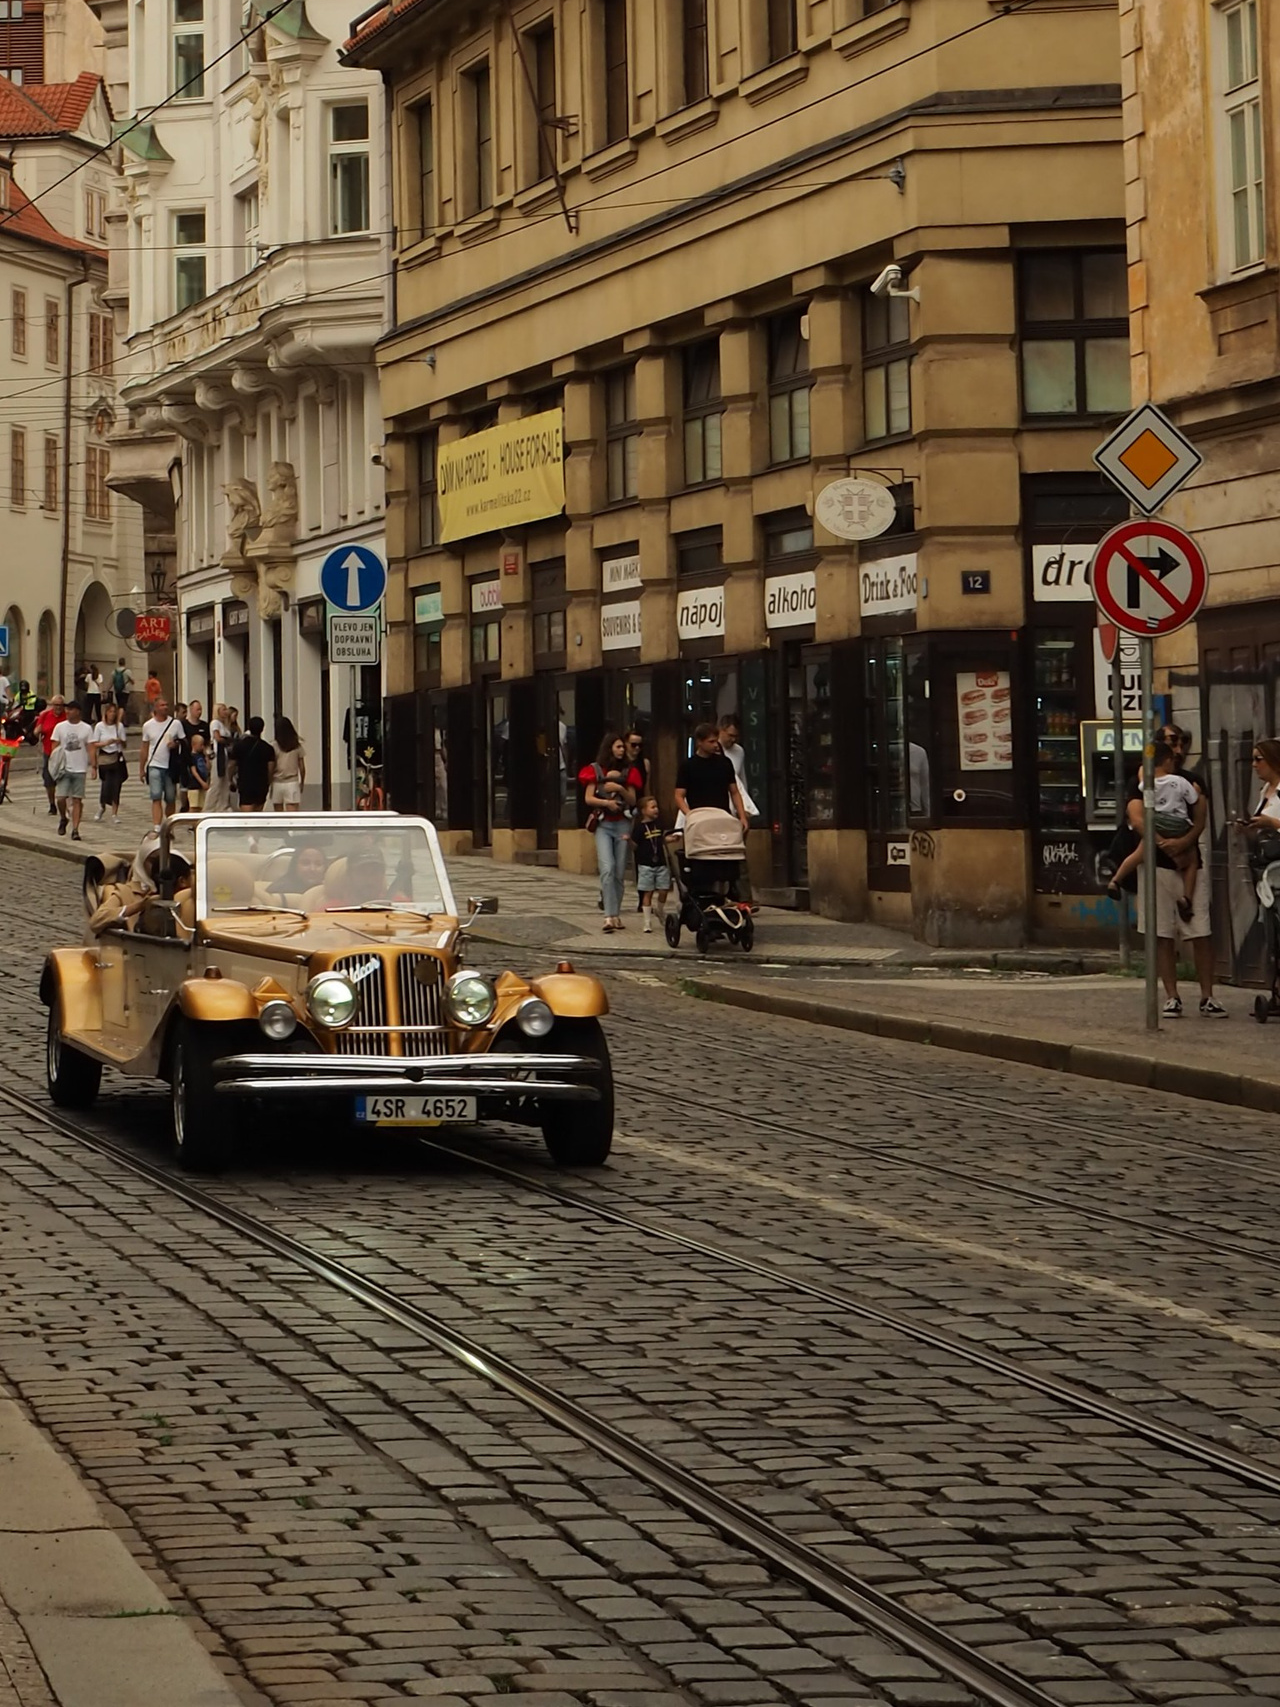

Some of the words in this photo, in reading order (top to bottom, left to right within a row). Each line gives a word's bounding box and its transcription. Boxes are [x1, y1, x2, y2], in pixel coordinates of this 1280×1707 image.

[465, 448, 489, 487] PRODEJ
[500, 438, 524, 476] HOUSE
[526, 433, 540, 471] FOR
[541, 428, 561, 465] SALE
[862, 571, 891, 604] Drink
[968, 576, 983, 589] 12
[768, 584, 816, 615] alkoho
[680, 596, 723, 630] nápoj
[140, 617, 167, 629] ART
[334, 622, 358, 632] VLEVO
[360, 622, 374, 632] JEN
[334, 633, 373, 644] DOPRAVNÍ
[336, 647, 372, 657] OBSLUHA
[371, 1098, 405, 1118] 4SR
[421, 1098, 468, 1118] 4652
